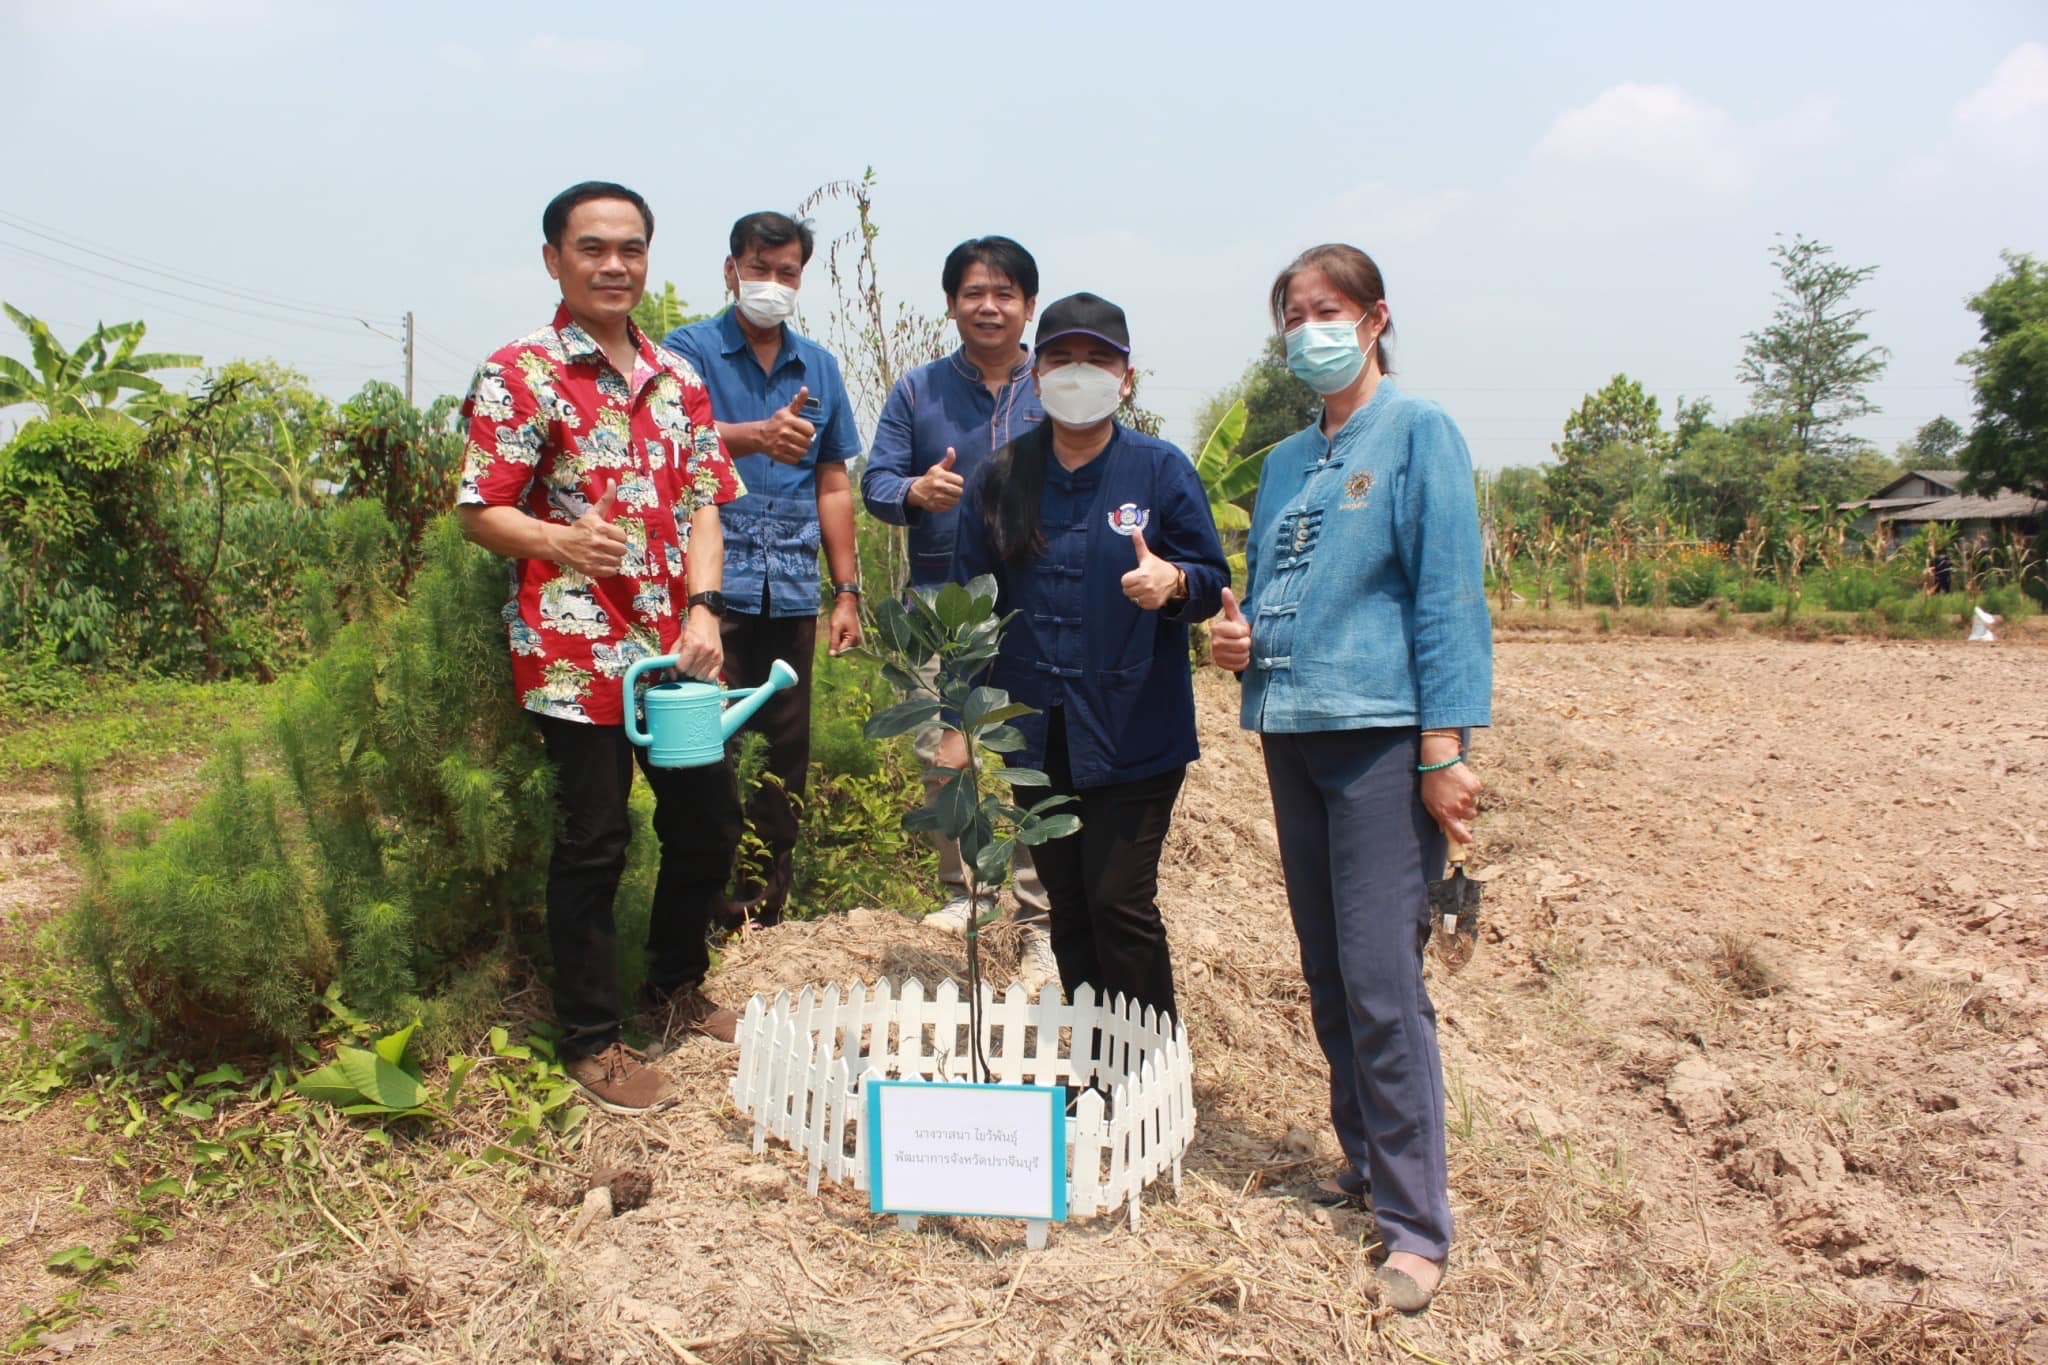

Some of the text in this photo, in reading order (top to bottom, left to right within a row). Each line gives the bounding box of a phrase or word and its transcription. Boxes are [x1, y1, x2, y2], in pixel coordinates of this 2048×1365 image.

[894, 1150, 1039, 1172] พัฒนาการจังหวัดปราจีนบุรี
